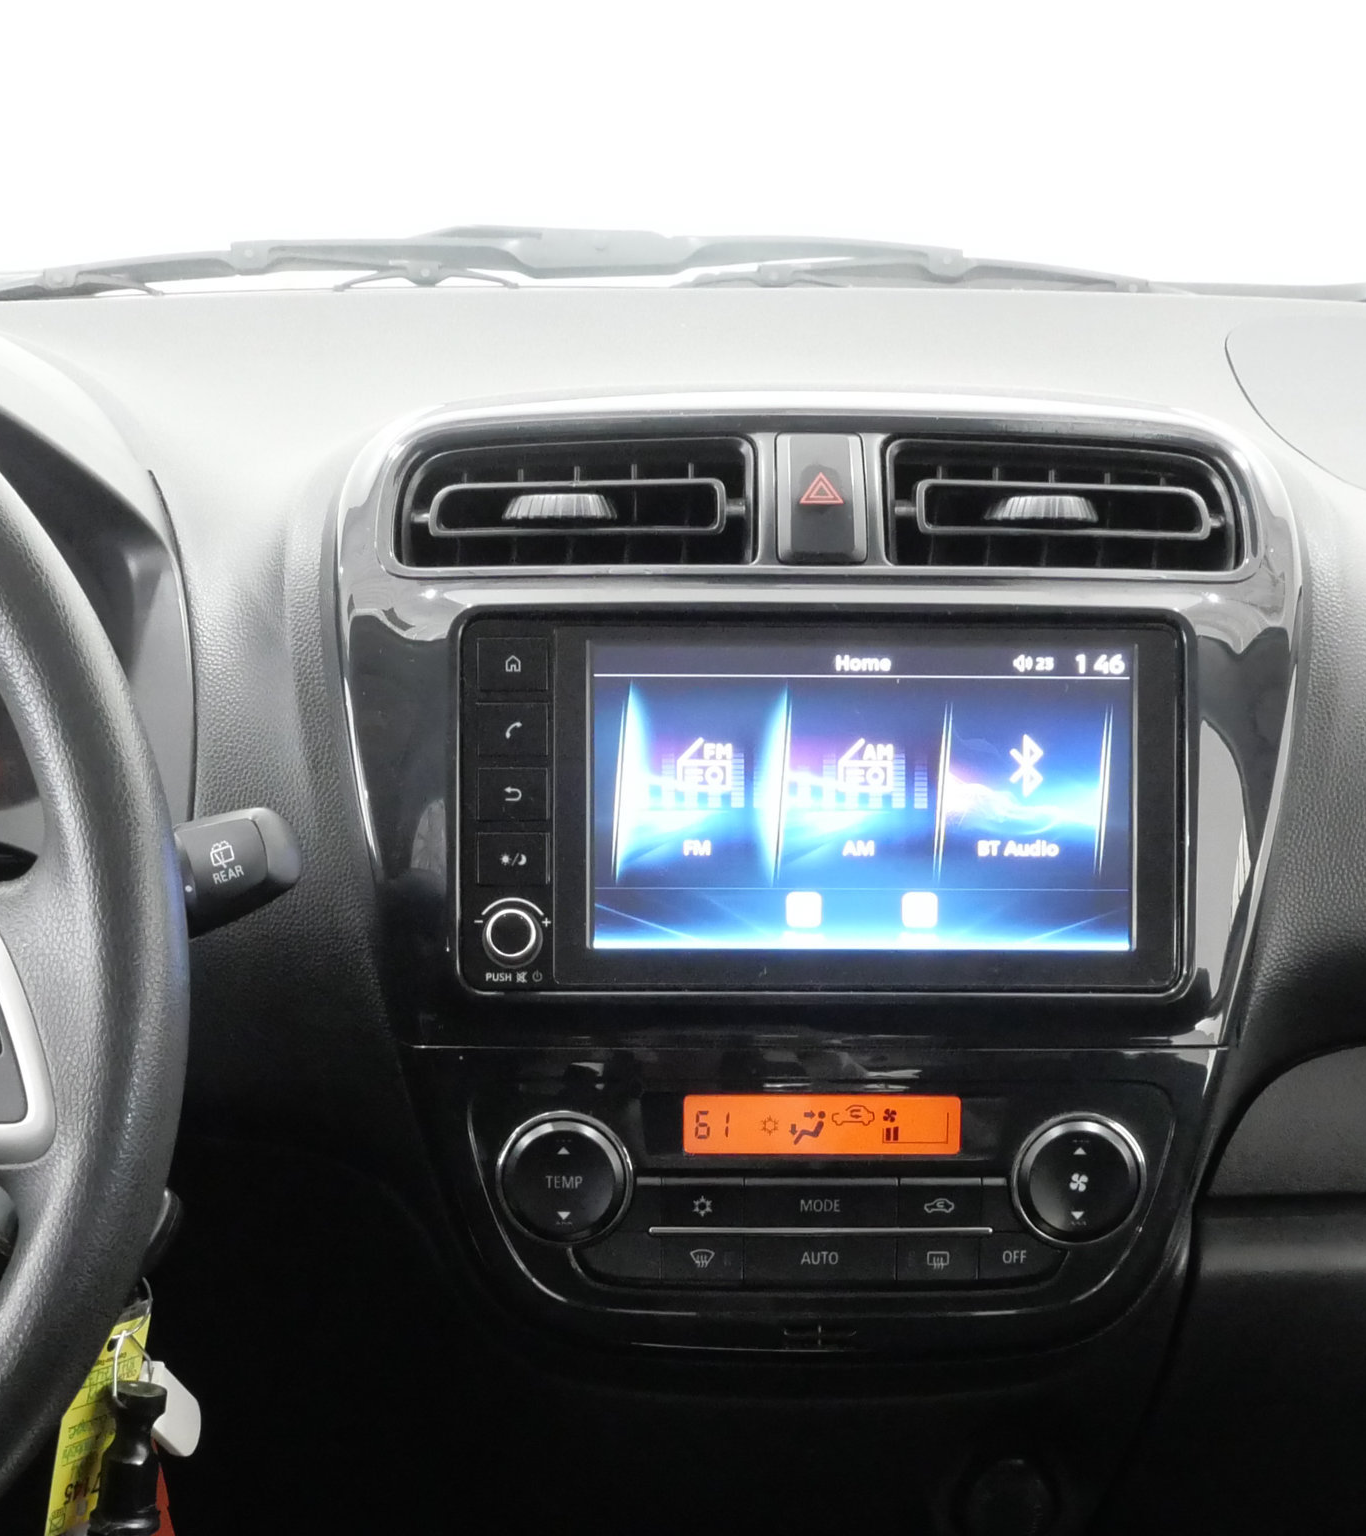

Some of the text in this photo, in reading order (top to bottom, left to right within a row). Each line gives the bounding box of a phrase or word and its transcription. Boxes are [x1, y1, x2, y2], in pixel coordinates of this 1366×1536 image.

[835, 654, 892, 672] Home
[703, 742, 733, 760] FM
[862, 743, 894, 760] AM
[682, 839, 712, 857] FM
[841, 839, 875, 857] AM
[976, 839, 1060, 857] BT Audio
[212, 864, 245, 885] REAR
[485, 972, 513, 982] PUSH
[694, 1109, 732, 1140] 61
[545, 1175, 584, 1190] TEMP
[800, 1198, 842, 1214] MODE
[800, 1251, 840, 1266] AUTO
[1001, 1249, 1028, 1265] OFF
